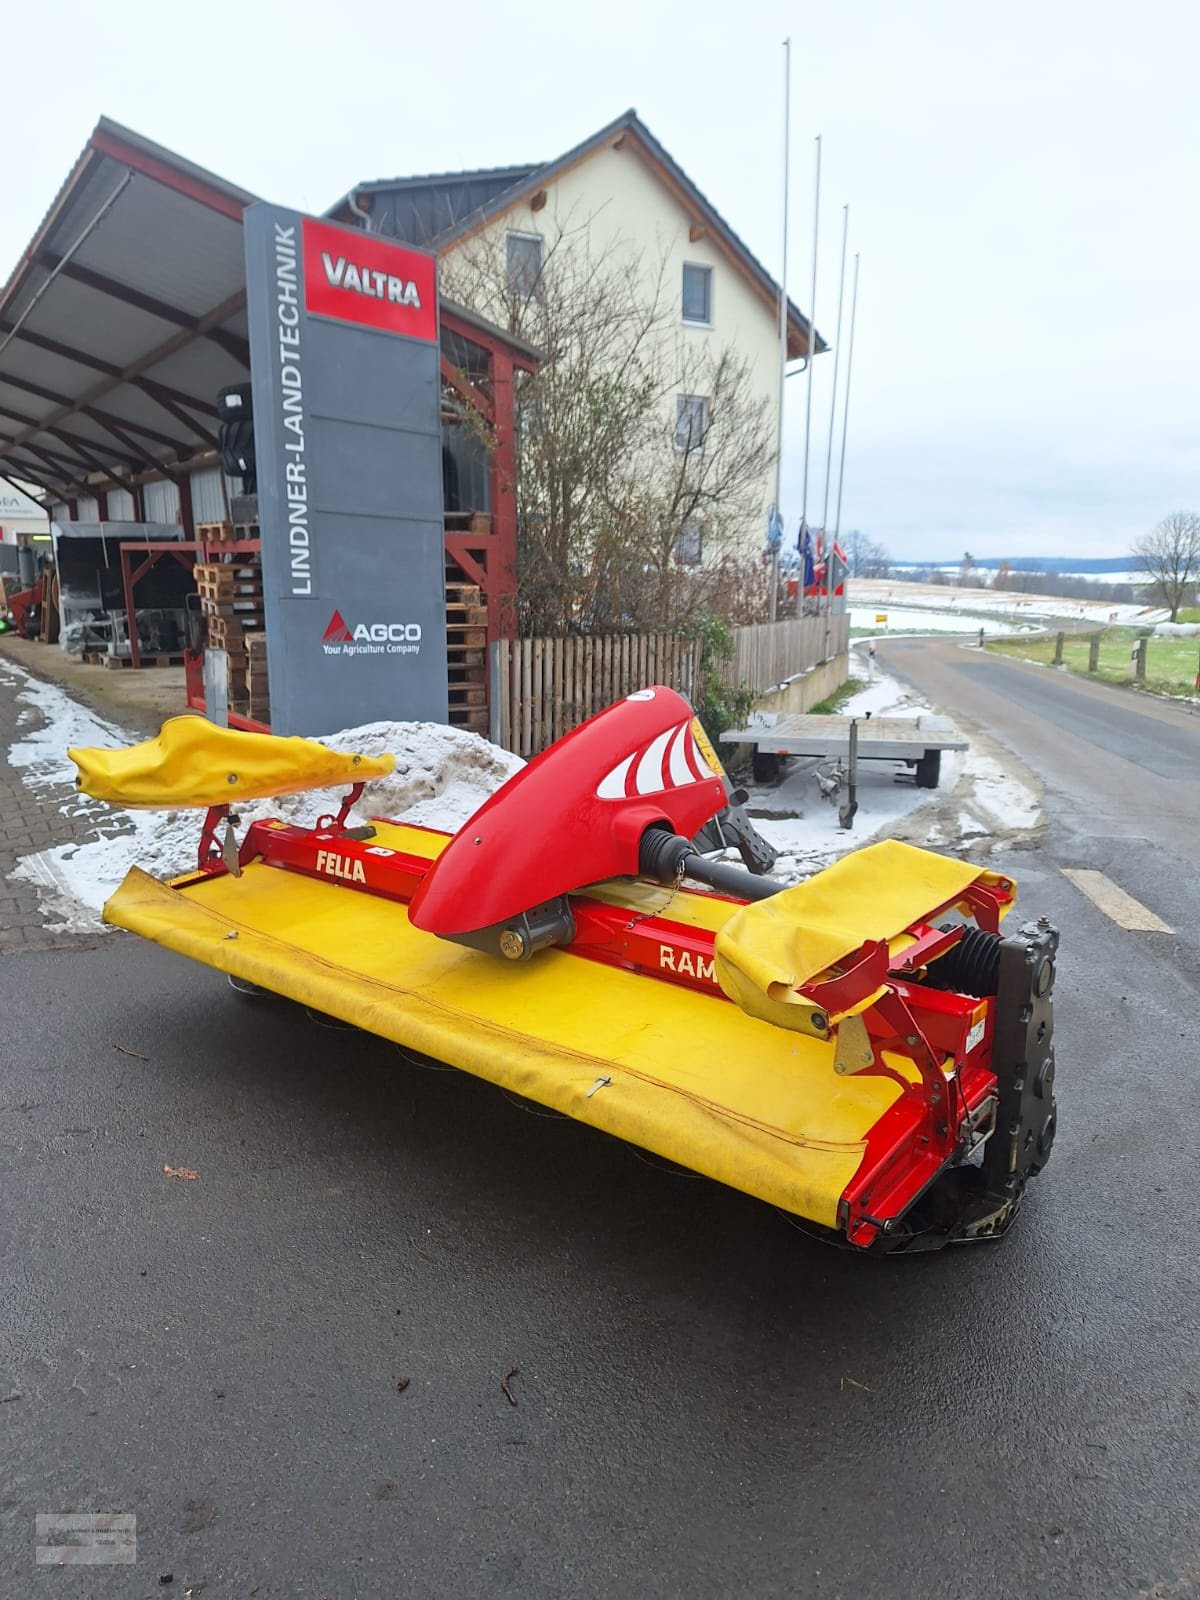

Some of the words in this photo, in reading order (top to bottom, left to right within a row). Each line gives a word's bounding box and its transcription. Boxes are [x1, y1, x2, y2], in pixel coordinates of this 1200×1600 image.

[321, 252, 422, 310] VALTRA
[274, 222, 311, 595] LINDNER-LANDTECHNIK
[322, 644, 341, 655] Your
[342, 643, 385, 656] Agriculture
[386, 643, 420, 655] Company
[353, 623, 422, 642] AGCO
[316, 849, 366, 884] FELLA
